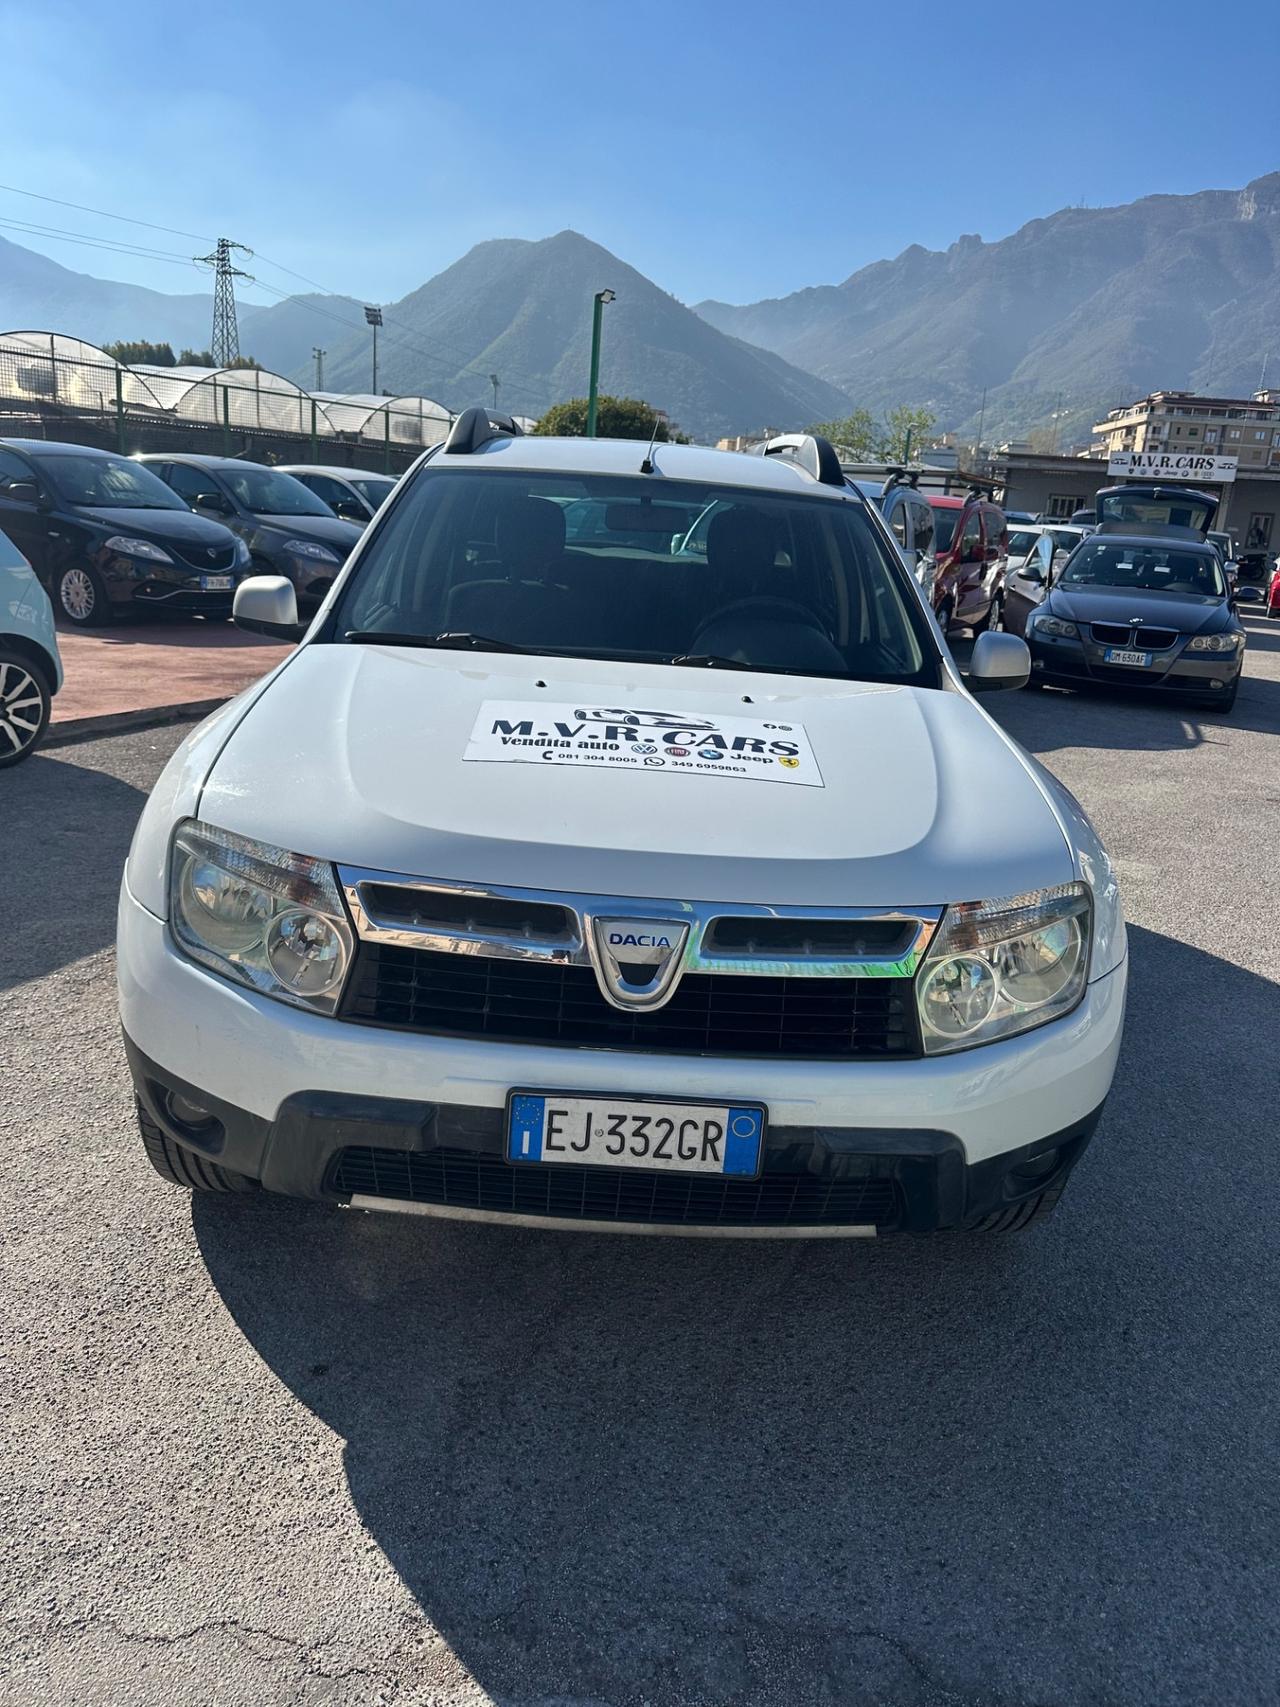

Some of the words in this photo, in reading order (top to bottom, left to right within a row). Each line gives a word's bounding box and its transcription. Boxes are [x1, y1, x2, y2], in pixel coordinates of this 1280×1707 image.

[577, 740, 620, 751] auto
[727, 751, 774, 764] Jeep
[671, 760, 693, 768] 349
[609, 933, 670, 948] DACIA
